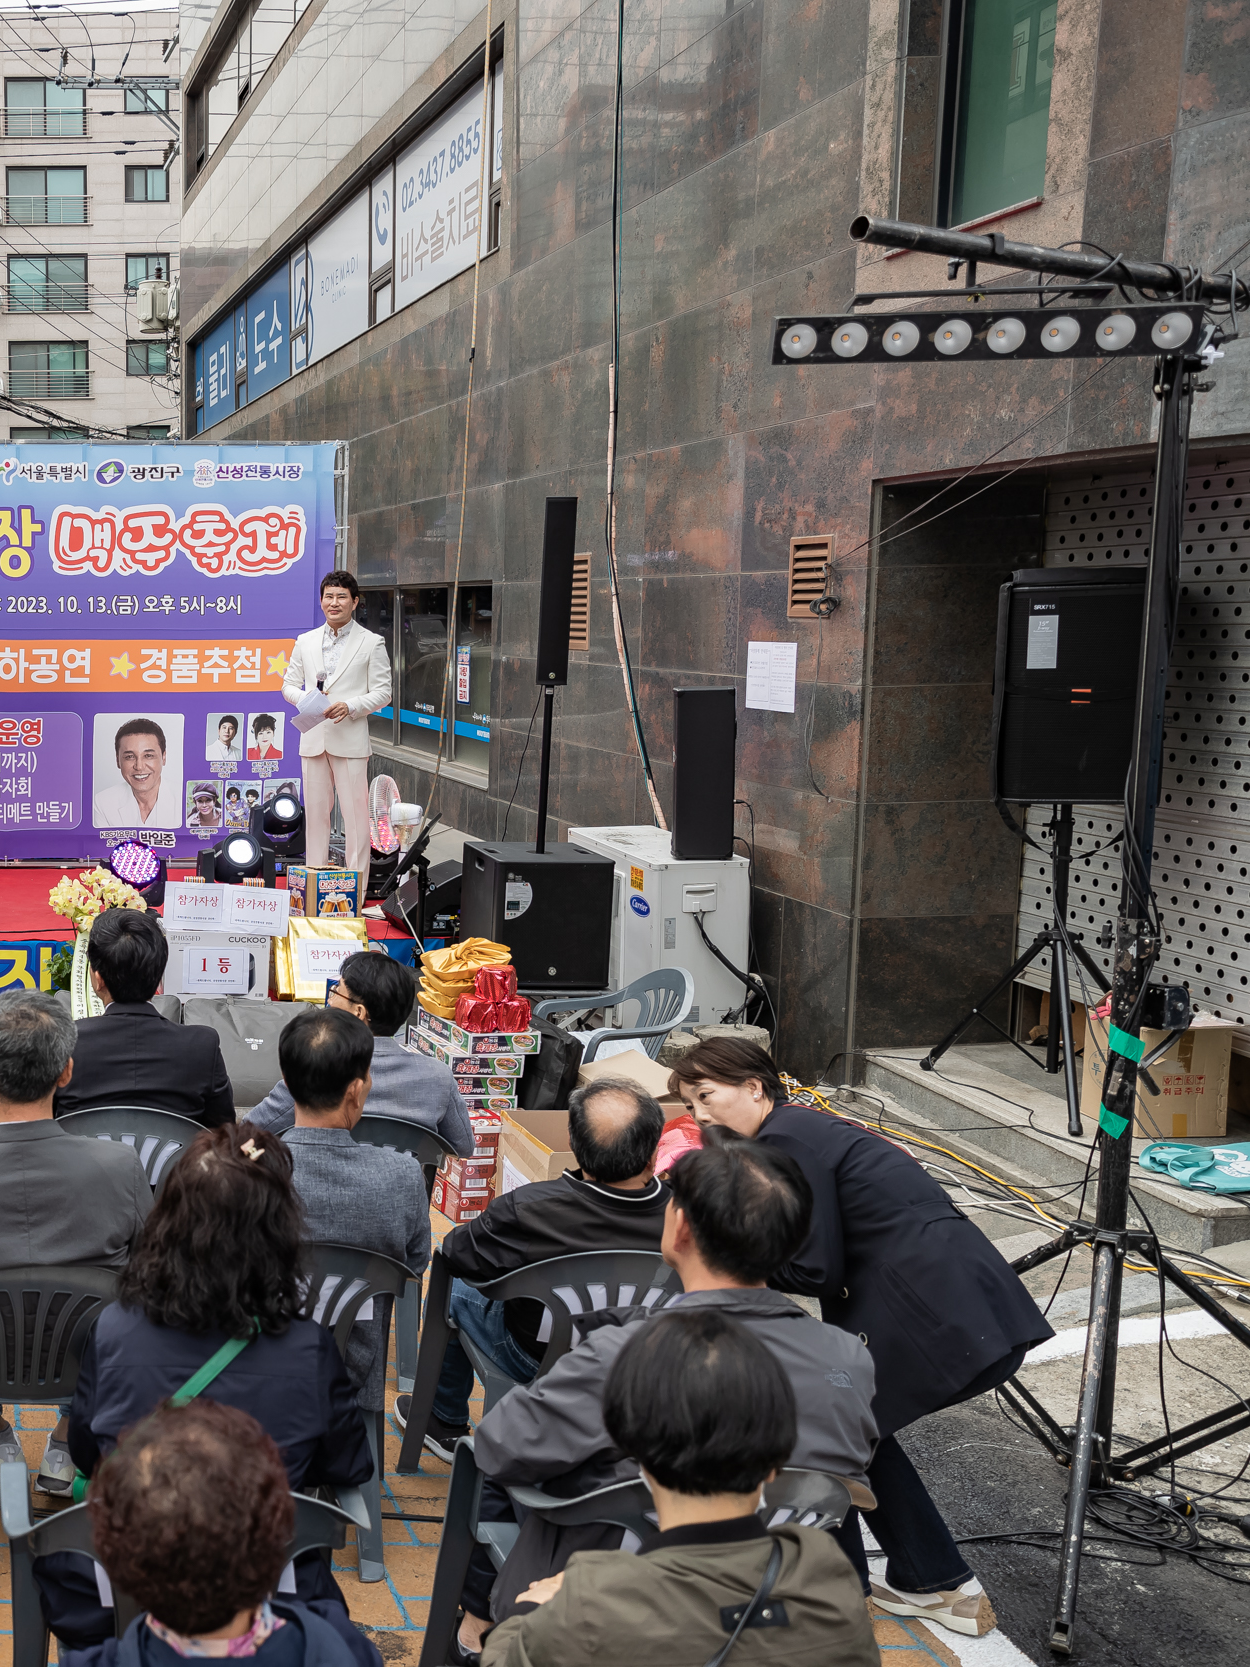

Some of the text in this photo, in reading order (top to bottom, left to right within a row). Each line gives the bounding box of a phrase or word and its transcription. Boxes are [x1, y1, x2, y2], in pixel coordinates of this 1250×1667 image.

[401, 118, 482, 213] 02.3437.8855
[400, 179, 480, 283] 비수술치료
[320, 253, 359, 297] BONEMADI
[253, 299, 283, 376] 도수
[209, 340, 230, 408] 물리
[19, 463, 87, 481] 서울특별시
[129, 464, 183, 481] 광진구
[215, 464, 302, 480] 신성전통시장
[52, 507, 304, 577] 맥주축제
[7, 596, 53, 615] 2023.
[57, 596, 83, 615] 10.
[88, 595, 139, 616] 13.(금)
[143, 595, 176, 614] 오후
[180, 595, 243, 616] 5시~8시
[139, 646, 263, 684] 경품추첨
[36, 802, 73, 823] 만들기
[139, 831, 175, 847] 박일준
[177, 894, 220, 908] 참가자상
[235, 897, 279, 912] 참가자상
[631, 898, 649, 912] Carrier
[228, 936, 267, 944] CUCKOO
[217, 957, 232, 974] 등
[457, 1084, 473, 1094] 개장
[1162, 1086, 1205, 1097] 취급주의
